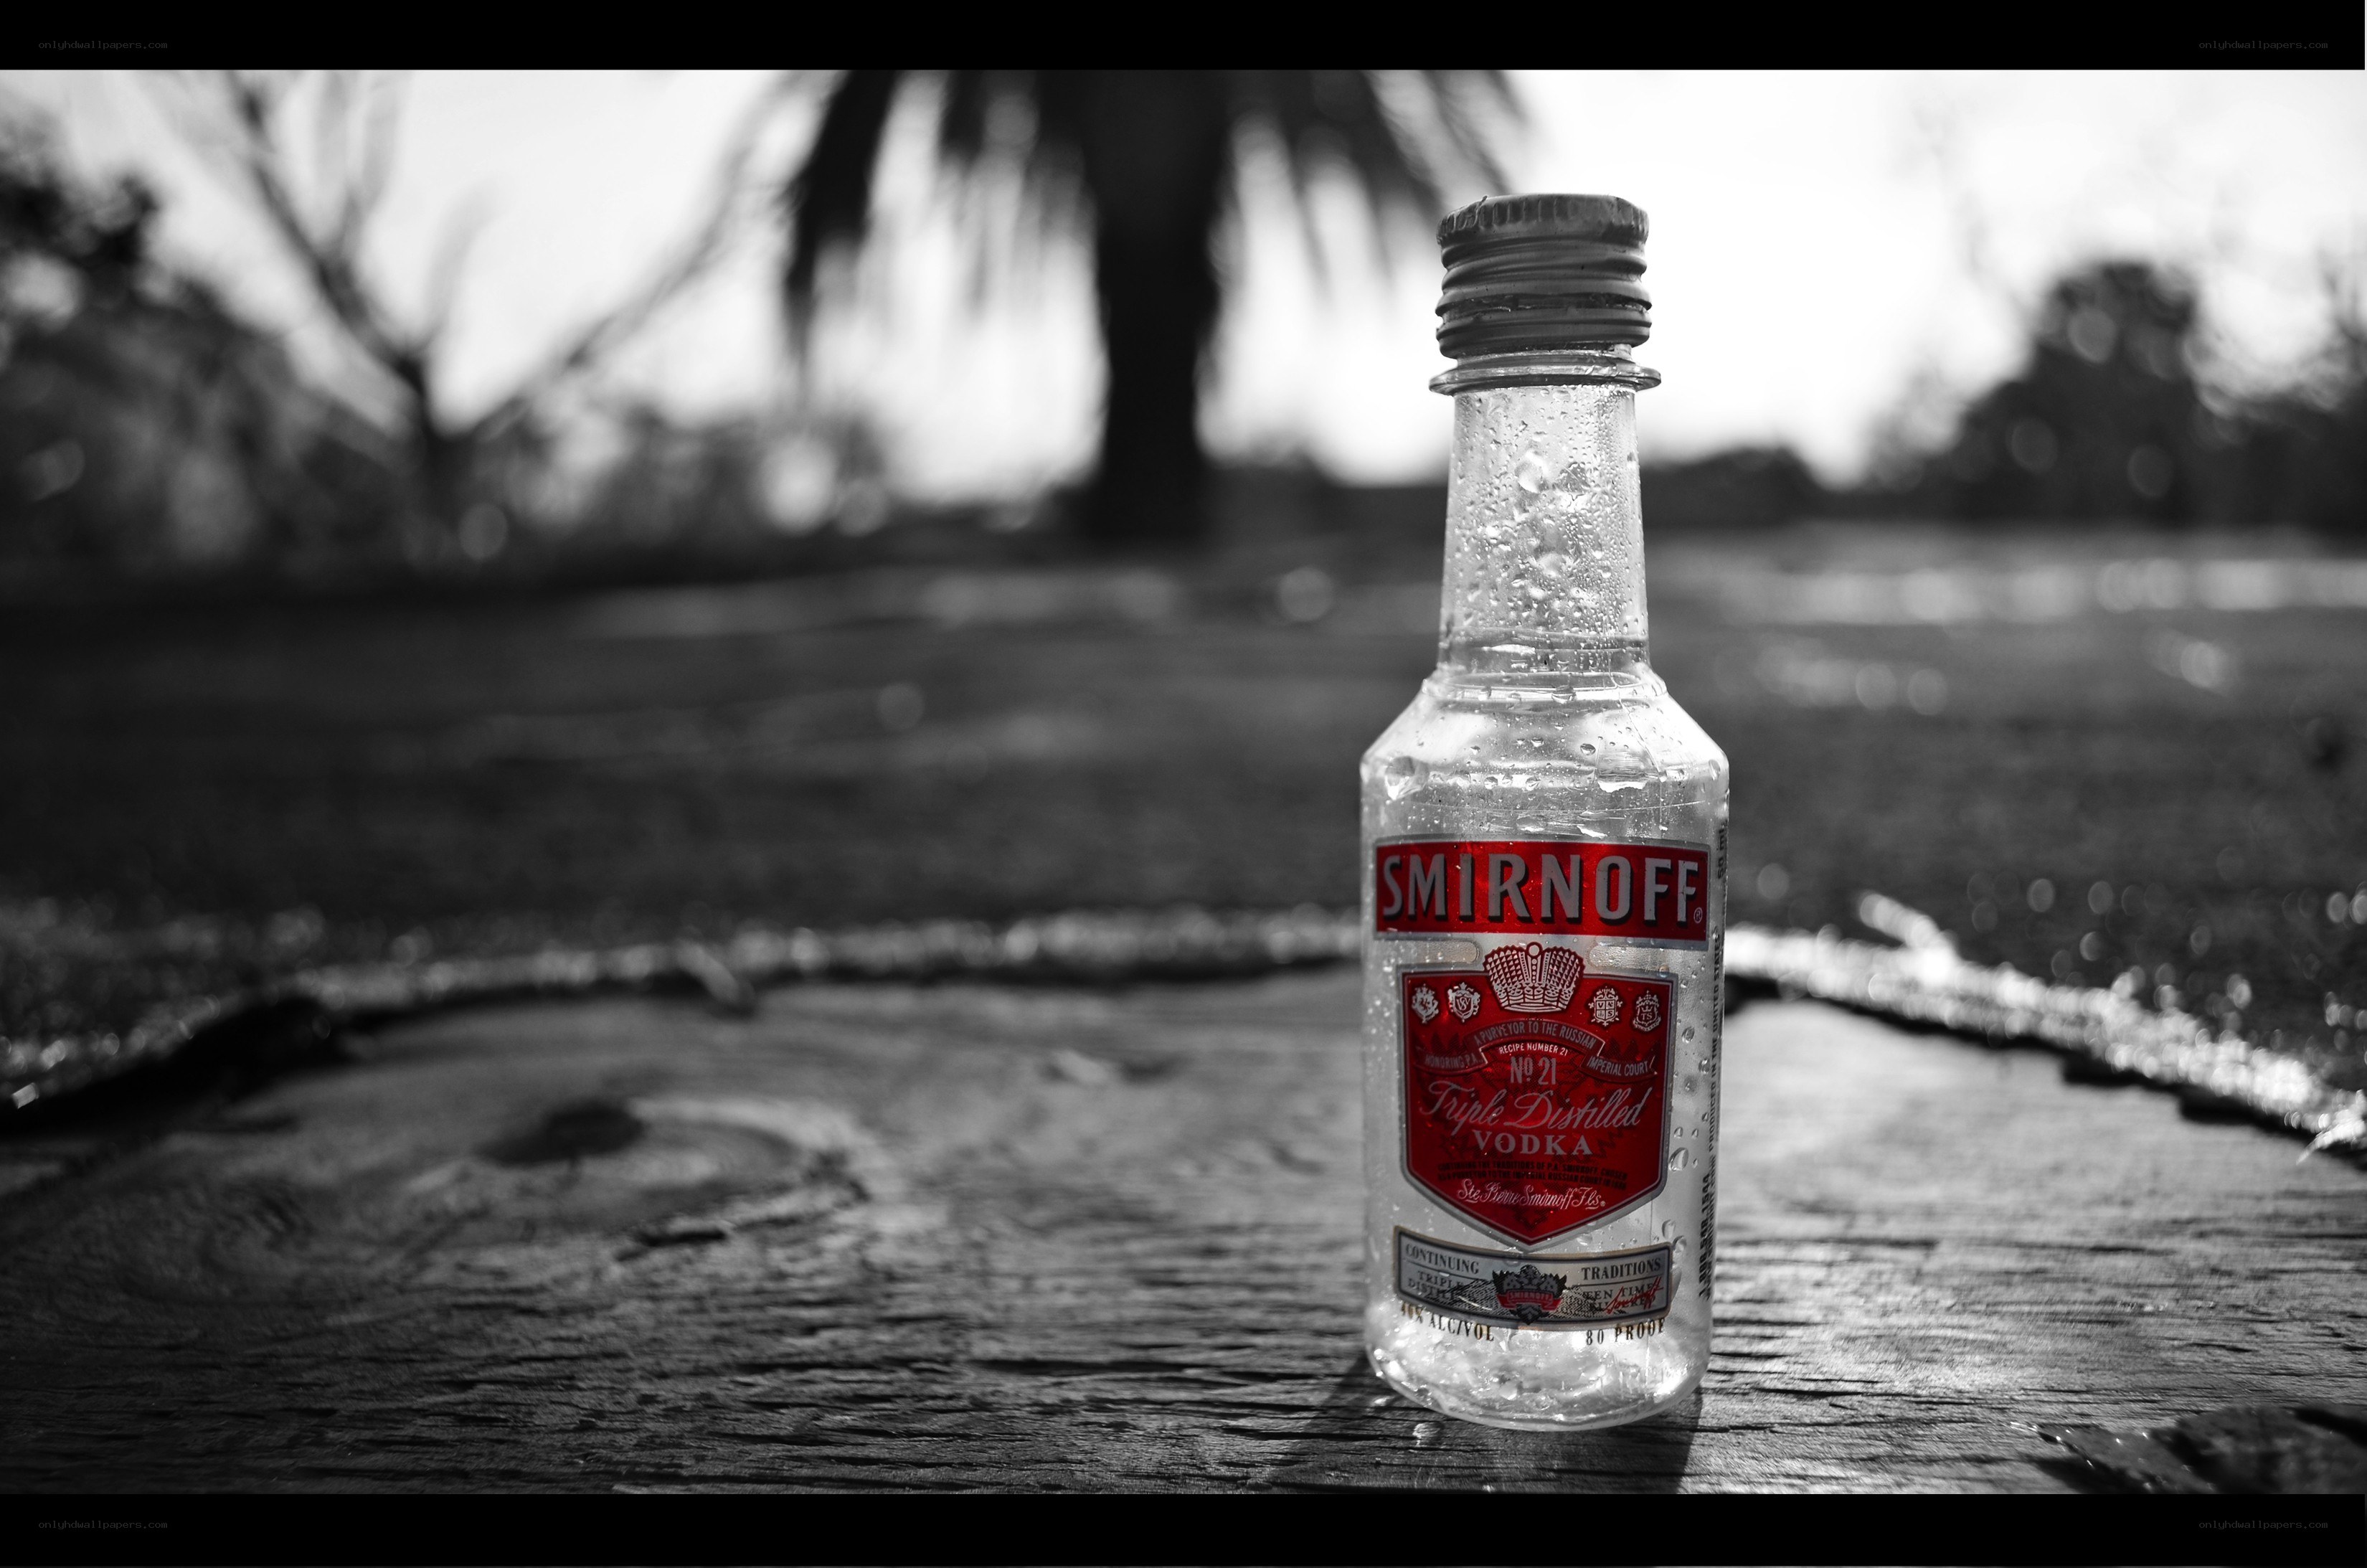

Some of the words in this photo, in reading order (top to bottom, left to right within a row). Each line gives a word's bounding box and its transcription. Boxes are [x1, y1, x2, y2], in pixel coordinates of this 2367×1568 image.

[1382, 853, 1699, 925] SMIRNOFF
[1480, 1021, 1526, 1044] PURVEYOR
[1529, 1021, 1539, 1033] TO
[1541, 1021, 1557, 1036] THE
[1559, 1025, 1597, 1049] RUSSIAN
[1498, 1042, 1524, 1054] RECIPE
[1527, 1042, 1558, 1054] NUMBER
[1559, 1047, 1569, 1057] 21
[1537, 1056, 1557, 1085] 21
[1587, 1056, 1622, 1076] IMPERIAL
[1624, 1060, 1648, 1077] COURT
[1419, 1080, 1507, 1136] Triple
[1503, 1086, 1653, 1130] Distilled
[1471, 1129, 1593, 1156] VODKA
[1406, 1244, 1480, 1275] CONTINUING
[1582, 1257, 1661, 1280] TRADITIONS
[1586, 1329, 1604, 1346] 80
[1615, 1317, 1666, 1342] PROOF
